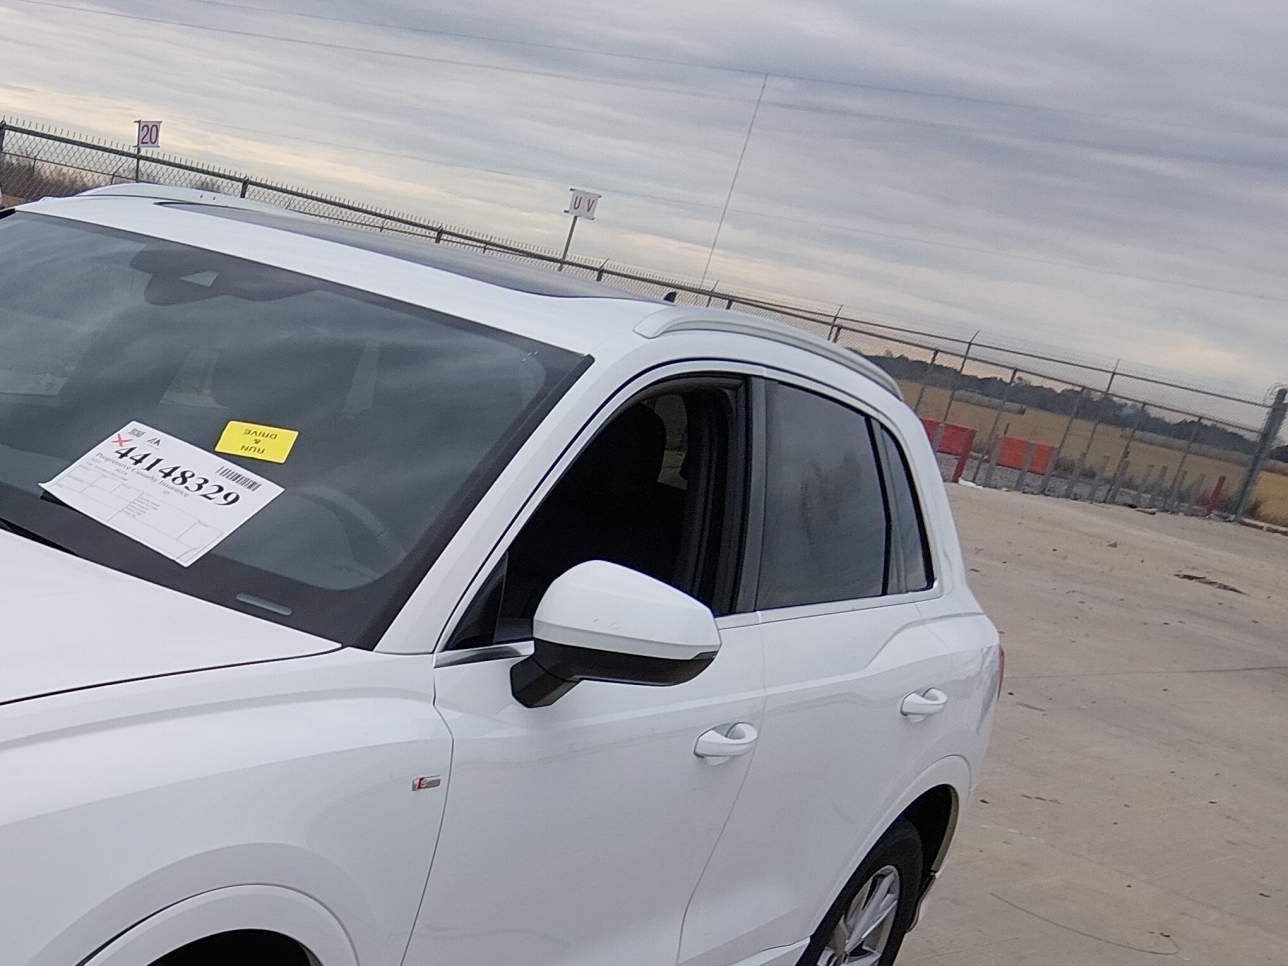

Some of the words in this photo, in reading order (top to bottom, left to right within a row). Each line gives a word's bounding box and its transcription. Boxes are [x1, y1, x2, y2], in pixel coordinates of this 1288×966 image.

[140, 123, 159, 145] 20
[573, 194, 583, 210] U
[586, 199, 595, 212] V
[243, 428, 278, 440] DRIVE
[240, 444, 266, 454] RUN
[114, 446, 240, 506] 44148329
